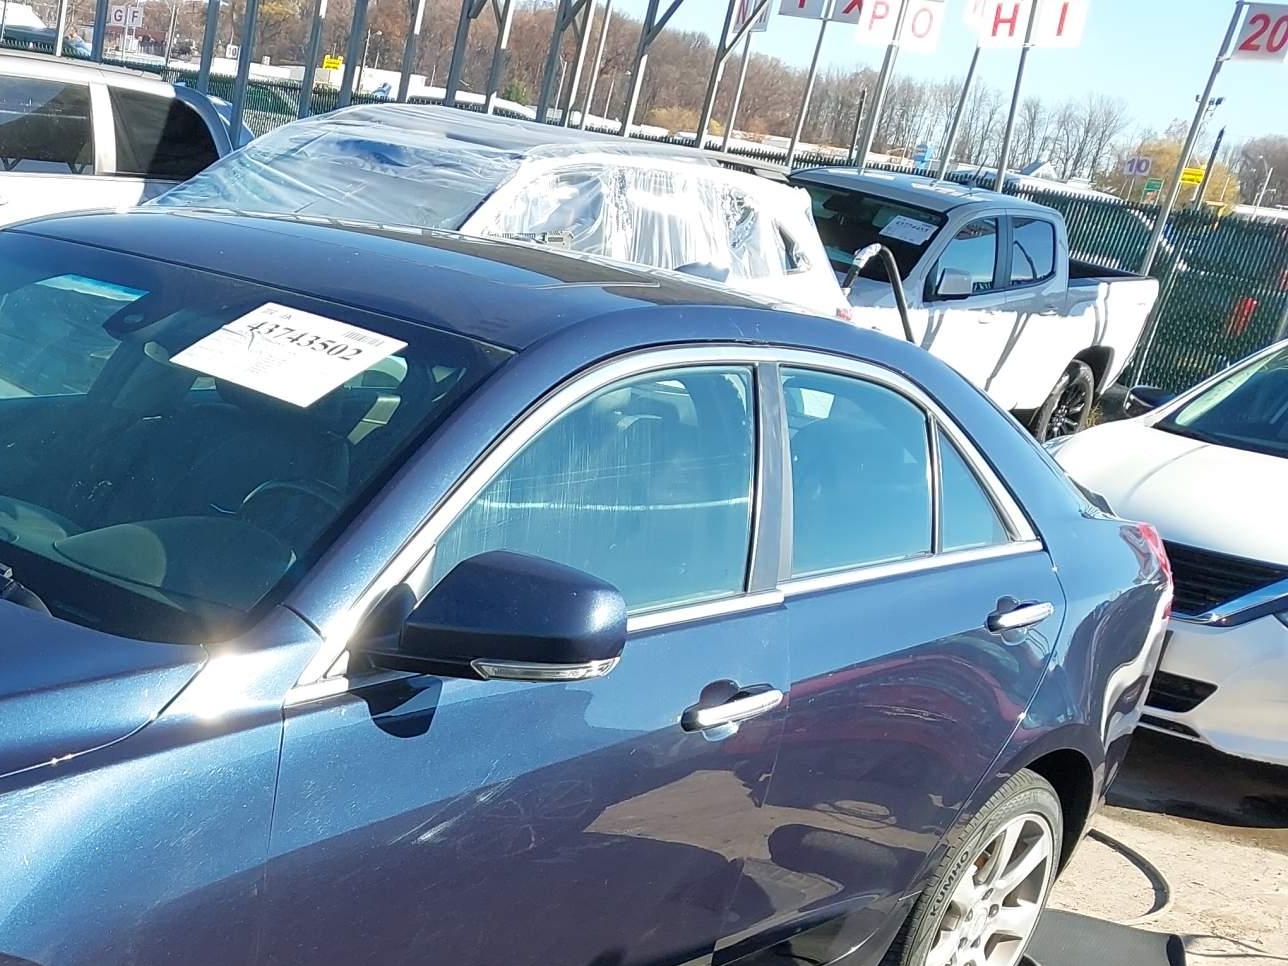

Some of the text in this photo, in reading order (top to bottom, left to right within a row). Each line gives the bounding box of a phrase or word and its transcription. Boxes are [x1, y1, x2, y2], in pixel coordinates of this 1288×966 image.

[114, 9, 139, 23] G F
[992, 3, 1020, 36] H
[1239, 13, 1288, 52] 20
[1127, 158, 1150, 173] 10
[247, 321, 363, 361] 43743502
[929, 851, 969, 916] KUMHO
